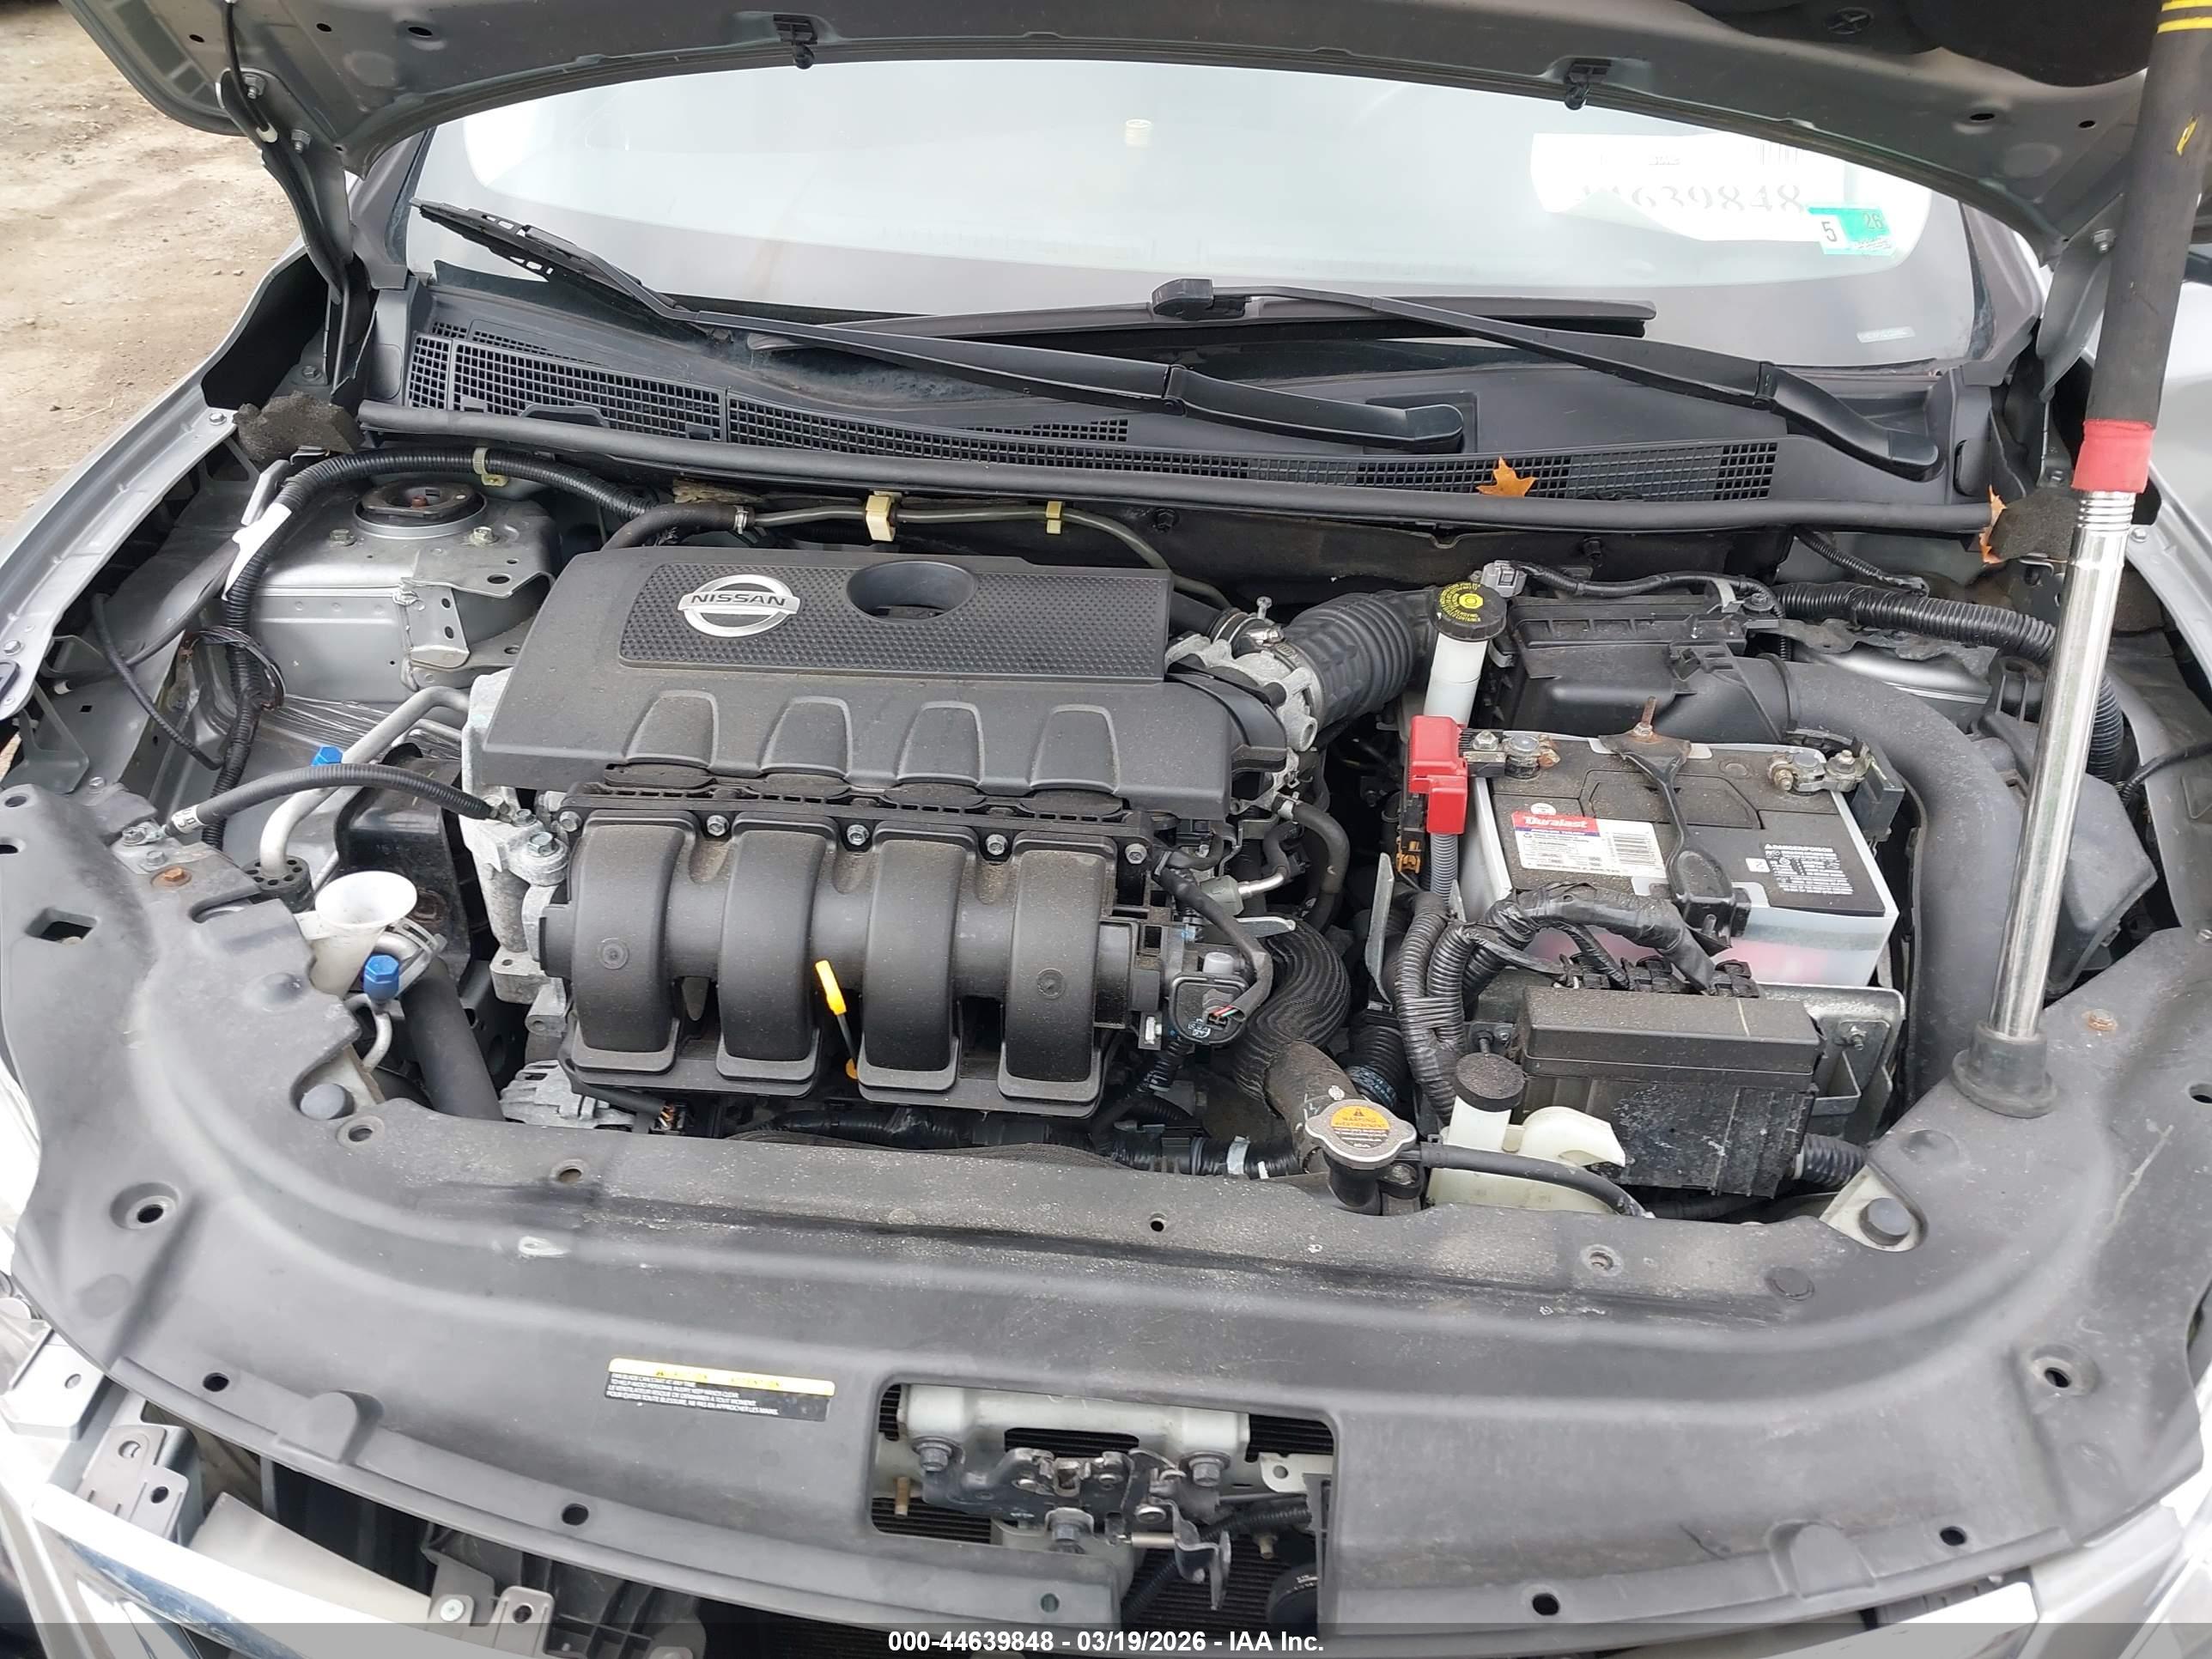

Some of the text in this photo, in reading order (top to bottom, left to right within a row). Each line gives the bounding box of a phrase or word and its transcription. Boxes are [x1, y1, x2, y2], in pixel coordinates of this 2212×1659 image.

[1863, 212, 1883, 229] 26
[1821, 221, 1838, 242] 5
[690, 593, 787, 606] NISSAN
[1524, 816, 1588, 829] Duralast
